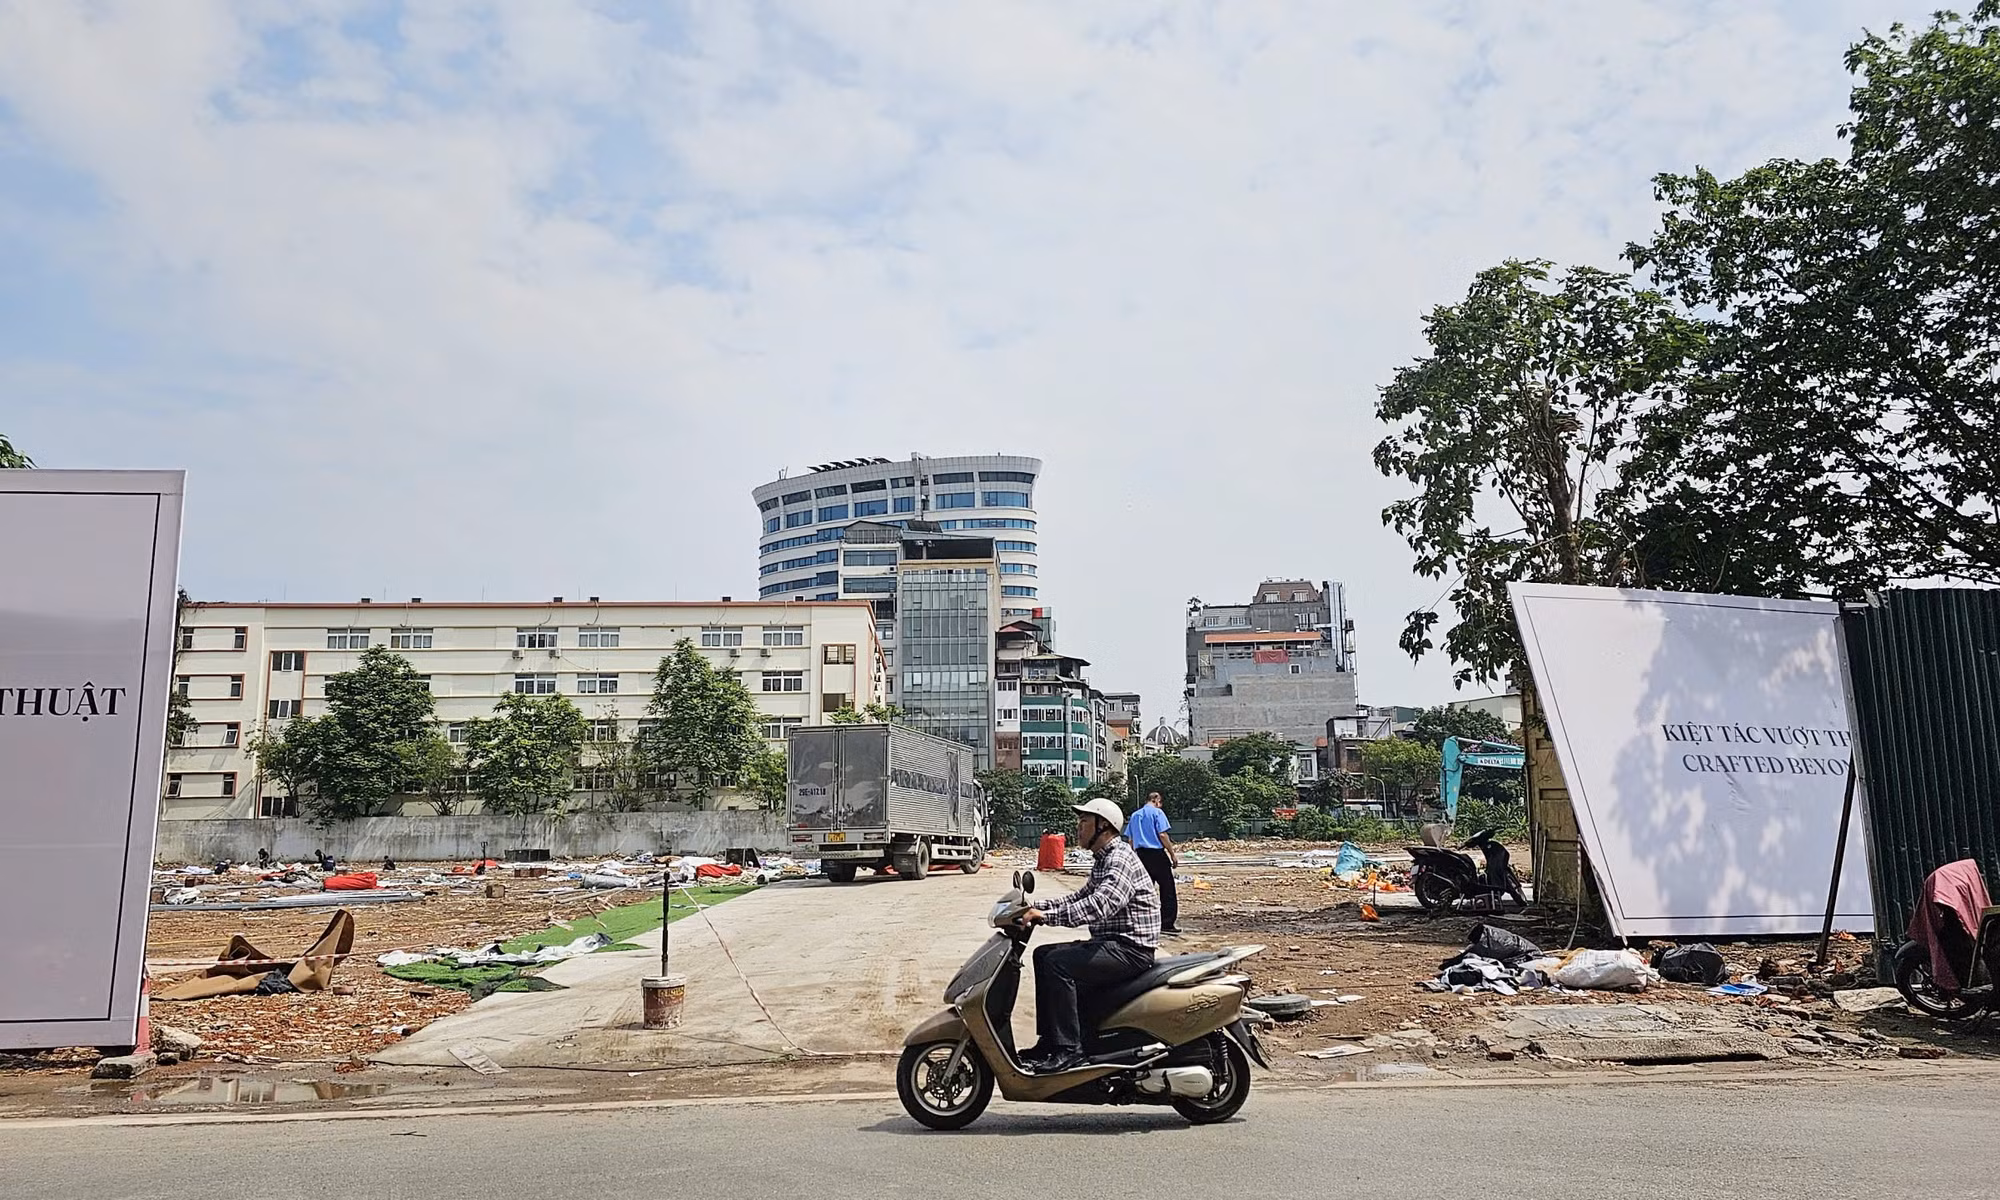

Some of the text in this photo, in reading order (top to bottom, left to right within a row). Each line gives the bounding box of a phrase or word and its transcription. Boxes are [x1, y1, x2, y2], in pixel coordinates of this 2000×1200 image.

[0, 681, 127, 722] THUẬT
[1661, 721, 1714, 746] KIỆT
[1716, 722, 1763, 744] TÁC
[1761, 725, 1821, 749] VƯỢT
[1682, 754, 1785, 774] CRAFTED
